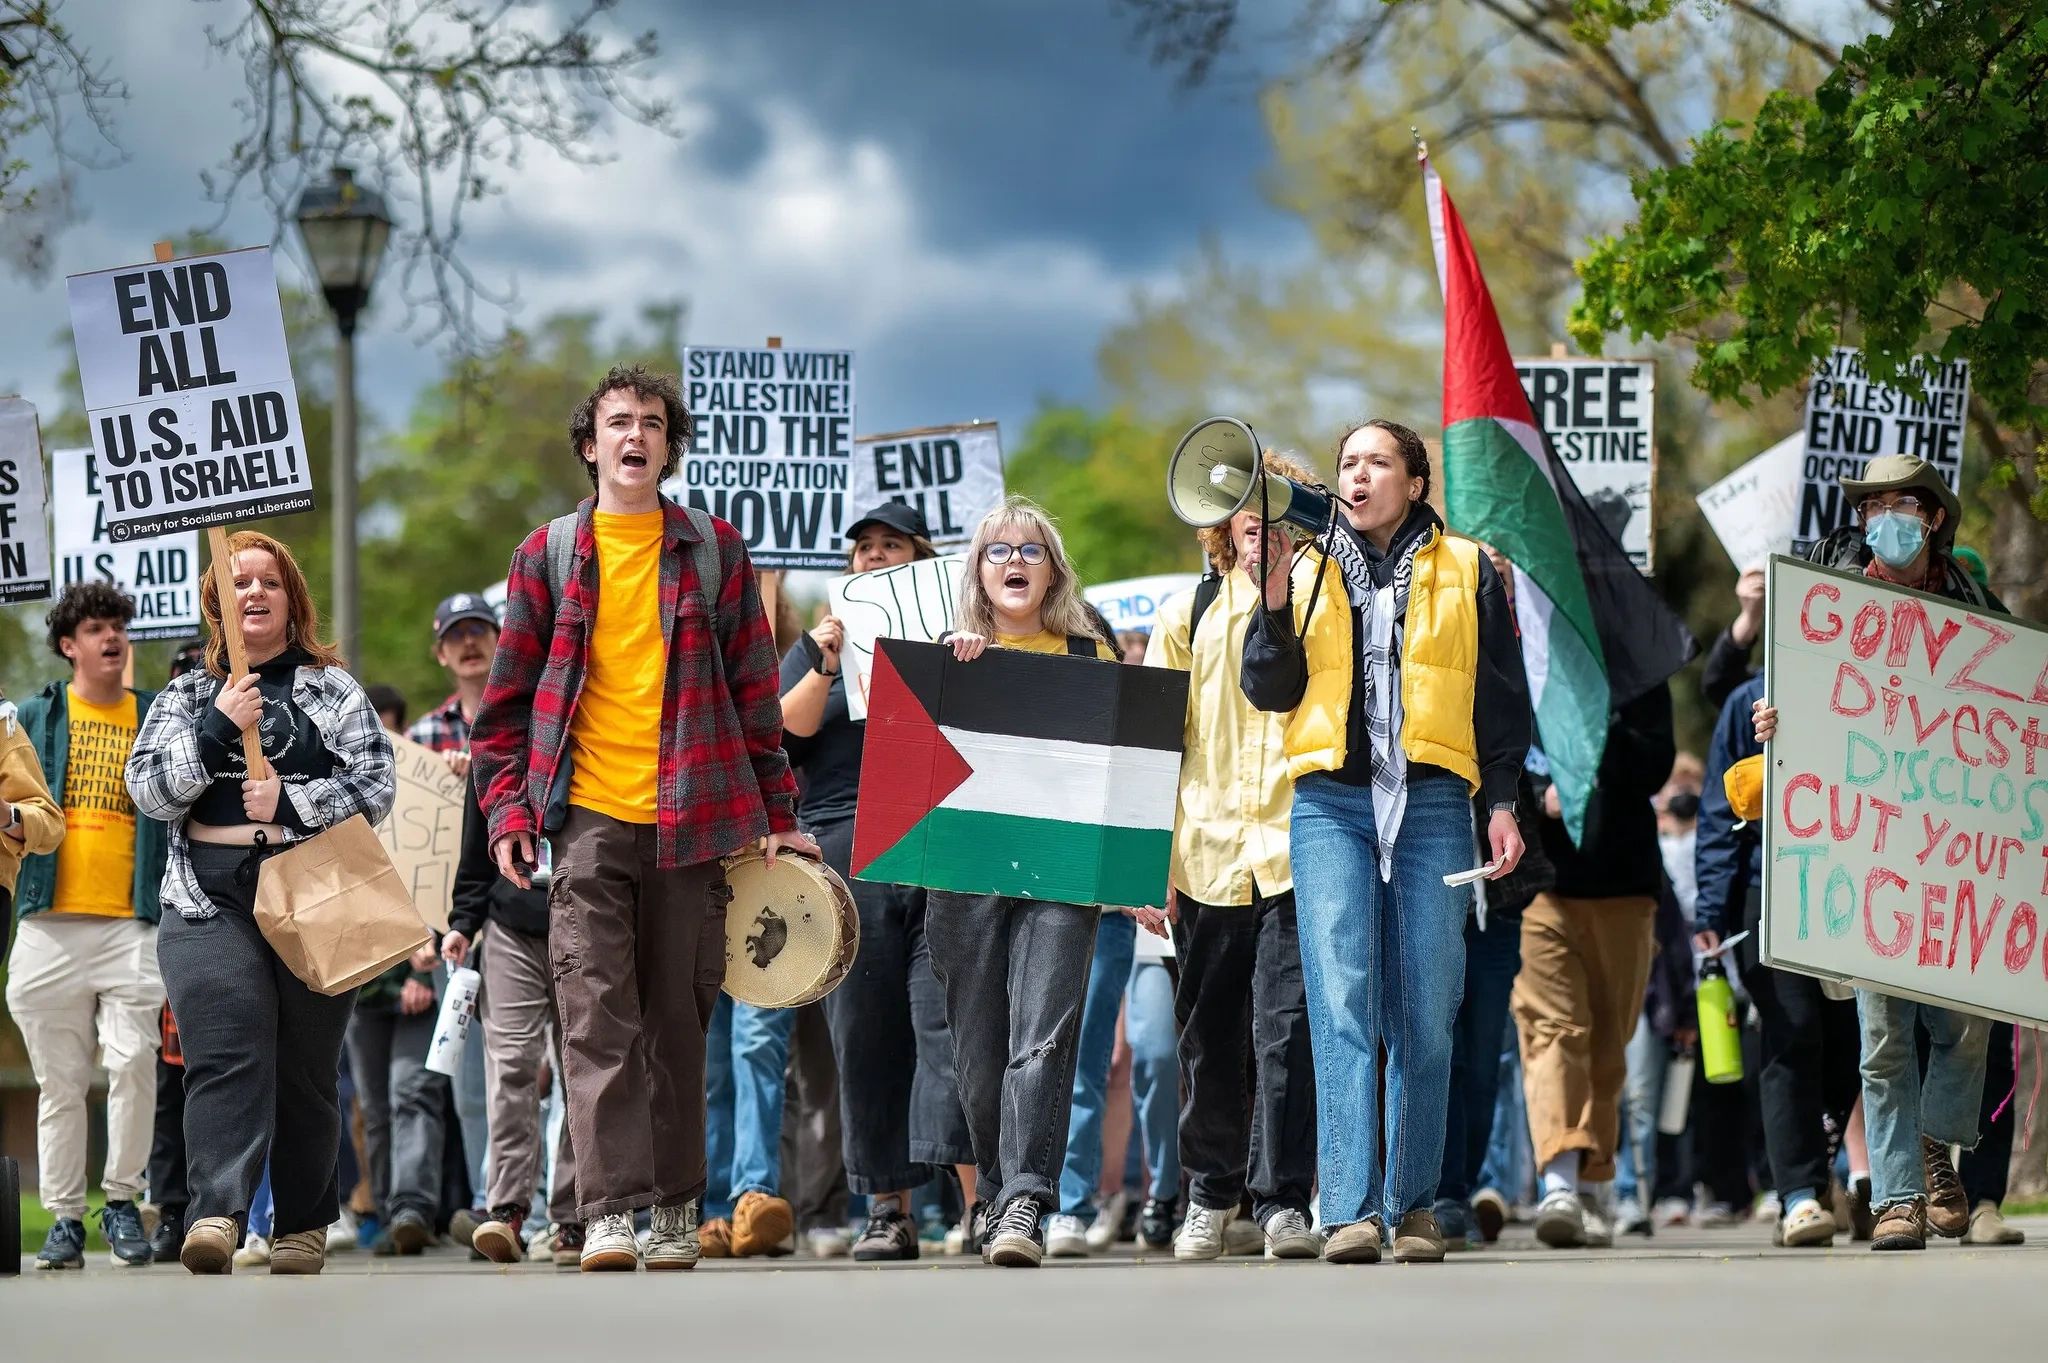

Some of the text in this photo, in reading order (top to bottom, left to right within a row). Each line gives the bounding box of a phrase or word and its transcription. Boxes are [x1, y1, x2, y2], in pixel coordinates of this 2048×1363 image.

[114, 262, 231, 335] END
[139, 326, 237, 397] ALL
[689, 351, 849, 381] STAND WITH
[690, 382, 848, 413] PALESTINE!
[100, 391, 288, 467] U.S. AID
[691, 414, 849, 457] END THE
[1809, 411, 1960, 463] END THE
[105, 473, 153, 512] TO
[160, 446, 300, 504] ISRAEL!
[687, 460, 847, 490] OCCUPATION
[874, 439, 962, 492] END
[133, 522, 162, 535] Party
[164, 518, 179, 530] for
[181, 511, 233, 527] Socialism
[235, 506, 255, 518] and
[257, 498, 311, 514] Liberation
[134, 549, 188, 586] AID
[412, 756, 437, 782] IN
[1783, 773, 1902, 853] CUT
[1776, 844, 1857, 940] TO
